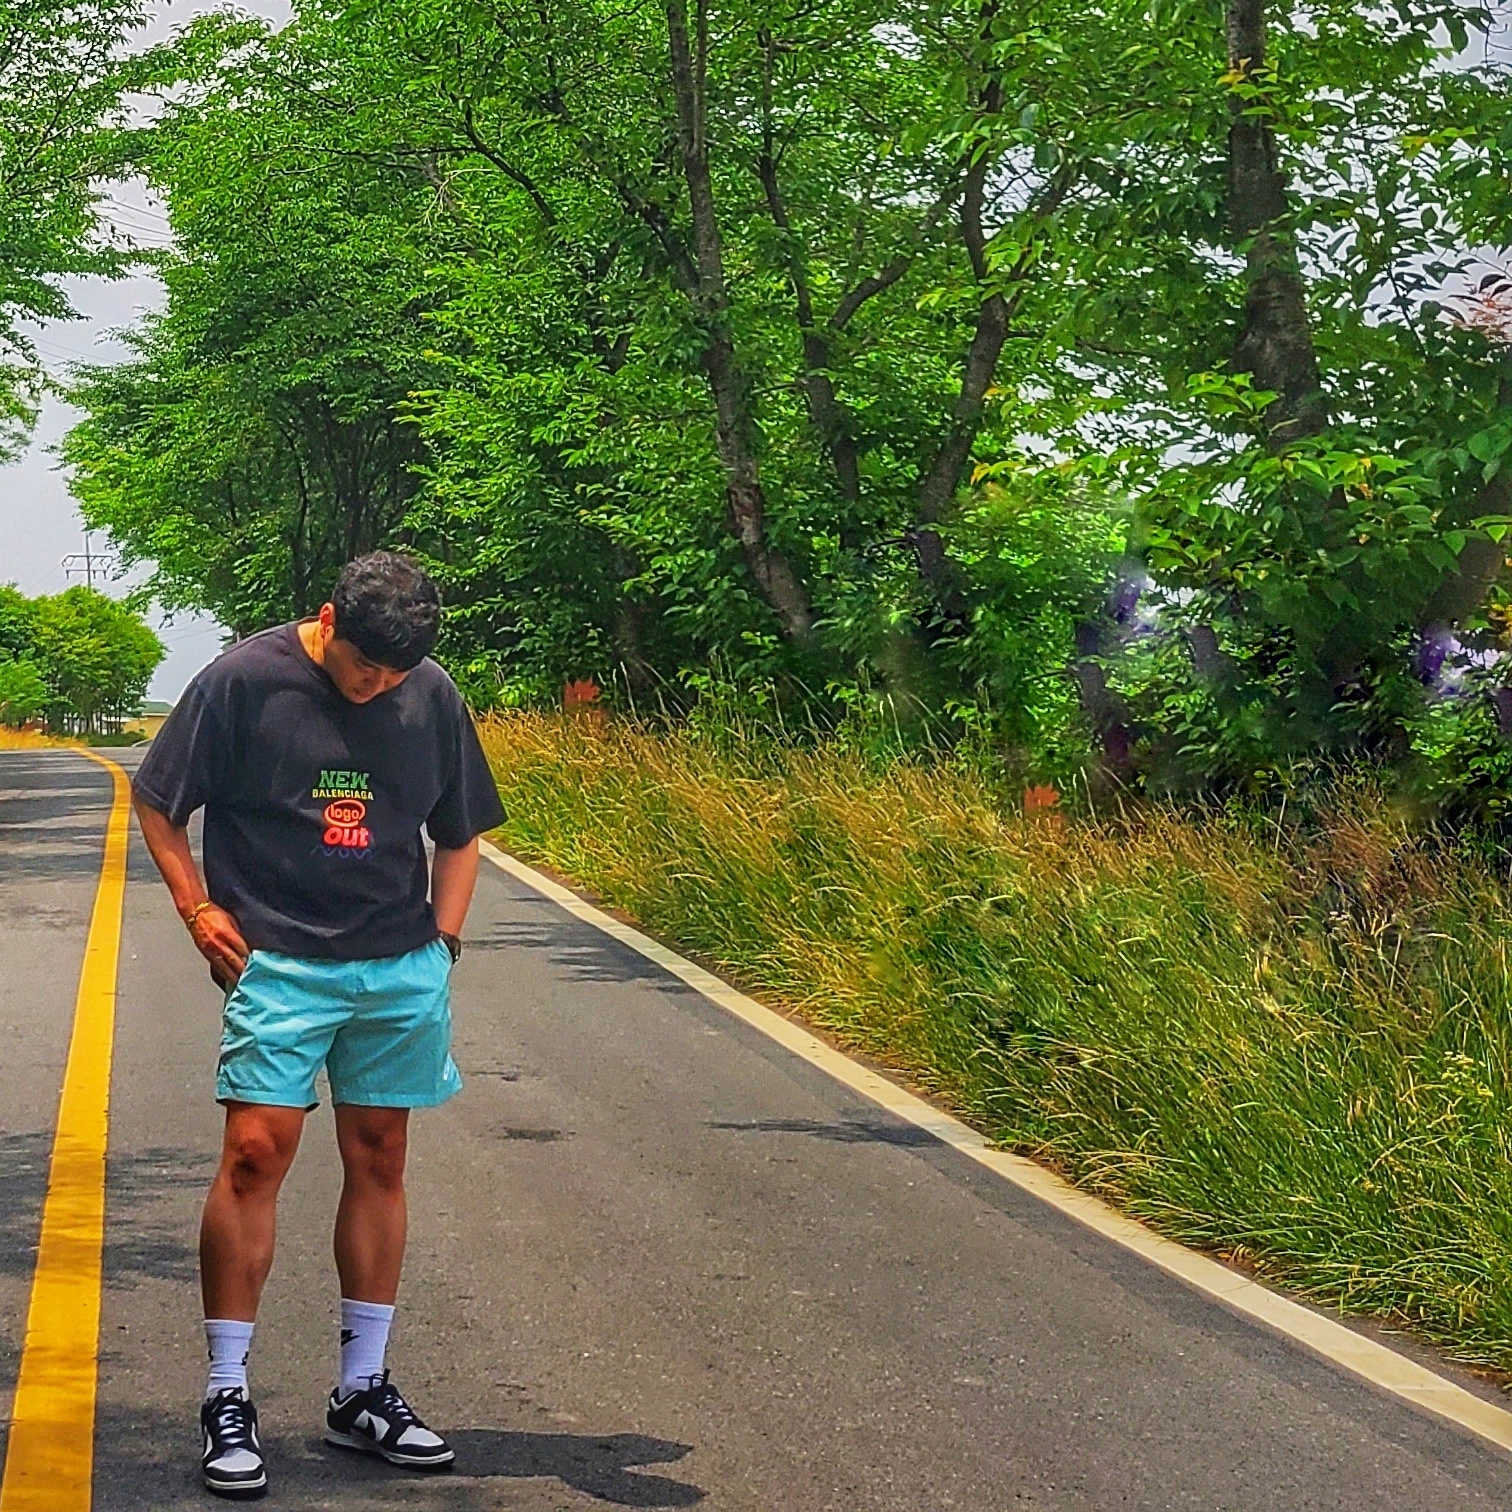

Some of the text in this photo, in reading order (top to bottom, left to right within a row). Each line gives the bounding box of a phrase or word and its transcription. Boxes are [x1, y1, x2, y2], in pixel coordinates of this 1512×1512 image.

[319, 770, 369, 789] NEW
[312, 789, 374, 800] BALENCIAGA
[330, 804, 359, 821] logo
